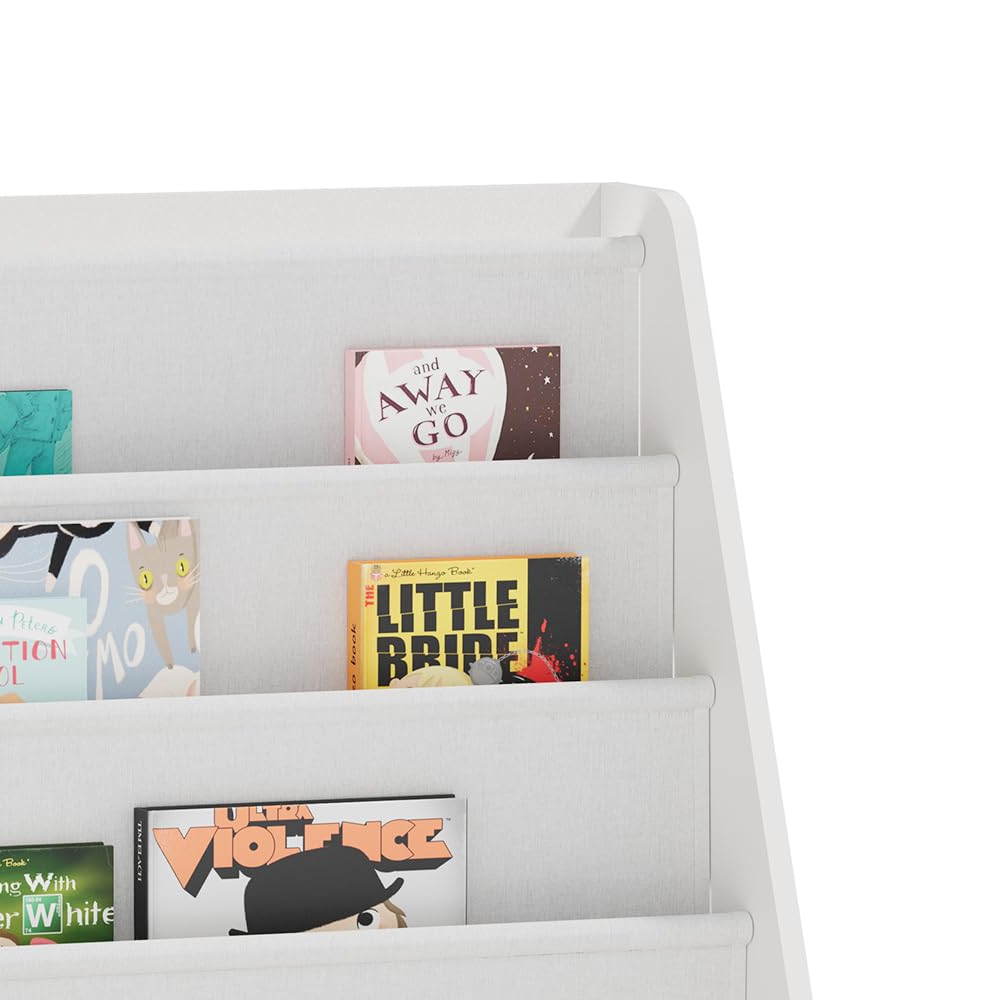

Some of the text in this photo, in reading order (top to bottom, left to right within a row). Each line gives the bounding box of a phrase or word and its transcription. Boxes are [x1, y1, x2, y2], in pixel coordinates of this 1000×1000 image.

[413, 357, 440, 376] and
[378, 369, 486, 422] AWAY
[425, 402, 447, 417] we
[412, 412, 468, 446] GO
[391, 568, 415, 578] Little
[365, 584, 375, 608] THE
[376, 579, 519, 633] LITTLE
[152, 818, 454, 893] VIOLENCE
[23, 872, 76, 893] With
